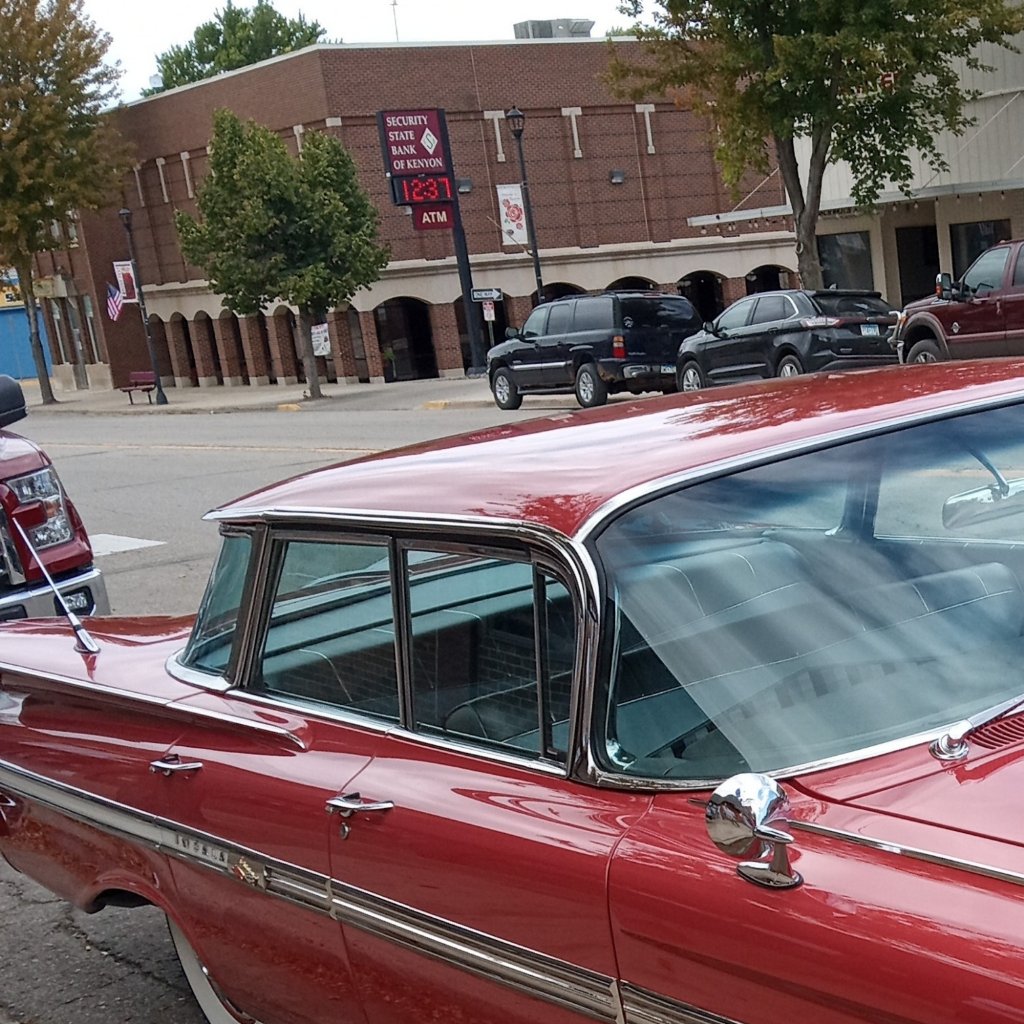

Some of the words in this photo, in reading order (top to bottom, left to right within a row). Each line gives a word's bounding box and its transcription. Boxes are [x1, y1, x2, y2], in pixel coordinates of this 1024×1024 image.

[386, 115, 428, 127] SECURITY
[389, 130, 415, 141] STATE
[391, 145, 417, 155] BANK
[393, 160, 405, 170] OF
[407, 157, 443, 168] KENYON
[422, 211, 447, 223] ATM
